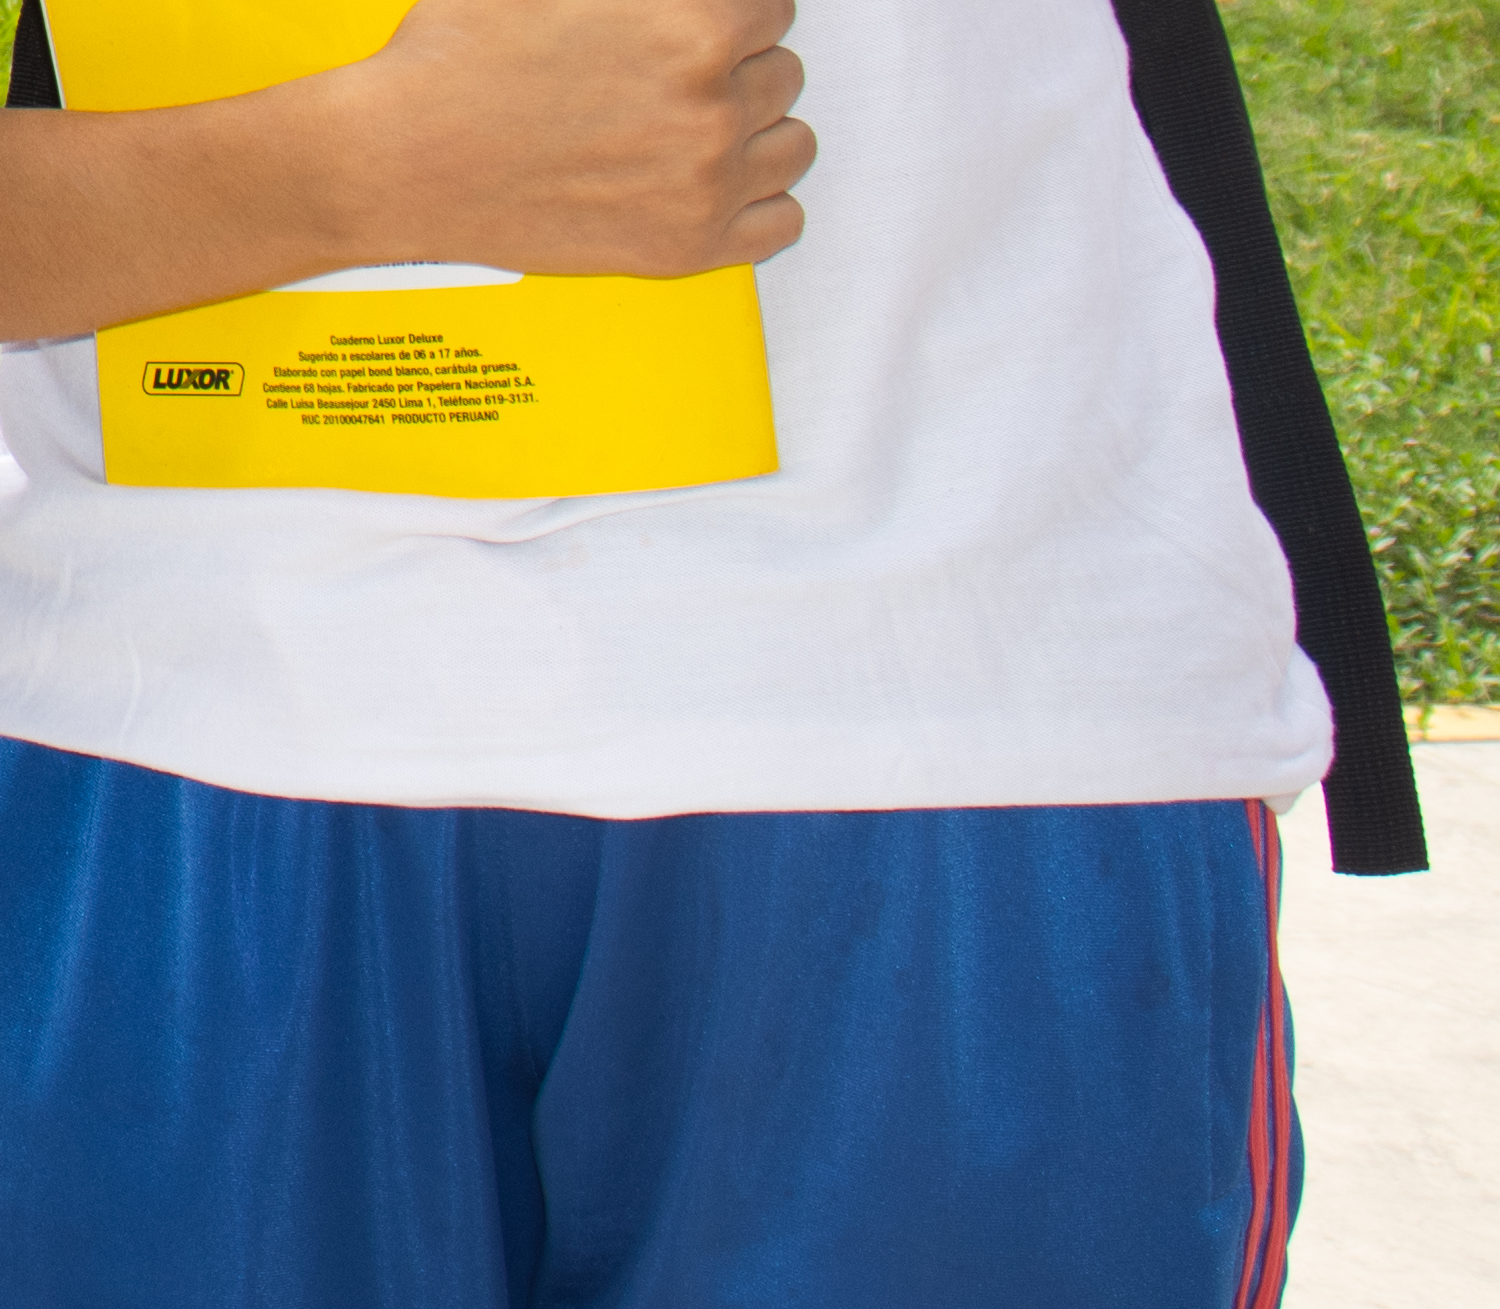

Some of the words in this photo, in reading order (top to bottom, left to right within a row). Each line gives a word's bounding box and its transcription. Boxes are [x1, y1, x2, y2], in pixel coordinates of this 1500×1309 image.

[329, 334, 375, 346] Cuaderno
[377, 334, 405, 346] Luxor
[408, 332, 444, 344] Deluxe
[298, 350, 339, 364] Sugerido
[341, 353, 347, 361] a
[349, 350, 396, 361] escolares
[398, 350, 411, 361] de
[413, 349, 427, 360] 06
[429, 351, 435, 359] a
[438, 348, 450, 359] 17
[454, 347, 483, 359] años.
[273, 366, 318, 378] Elaborado
[320, 368, 337, 378] con
[339, 366, 366, 380] papel
[367, 366, 393, 377] bond
[395, 365, 433, 377] blanco,
[434, 363, 478, 375] carátula
[480, 362, 521, 376] gruesa.
[262, 382, 301, 393] Contiene
[303, 383, 315, 393] 68
[316, 382, 345, 395] hojas.
[347, 382, 395, 393] Fabricado
[397, 383, 414, 394] por
[416, 381, 462, 394] Papelera
[464, 377, 511, 390] Nacional
[513, 375, 536, 388] S.A.
[265, 398, 288, 409] Calle
[290, 398, 315, 409] Luisa
[316, 398, 369, 411] Beausejour
[371, 397, 396, 409] 2450
[398, 397, 423, 409] Lima
[426, 397, 436, 409] 1,
[438, 396, 482, 407] Teléfono
[484, 392, 539, 405] 619-3131.
[301, 413, 321, 425] RUC
[391, 412, 447, 425] PRODUCTO
[449, 410, 499, 423] PERUANO
